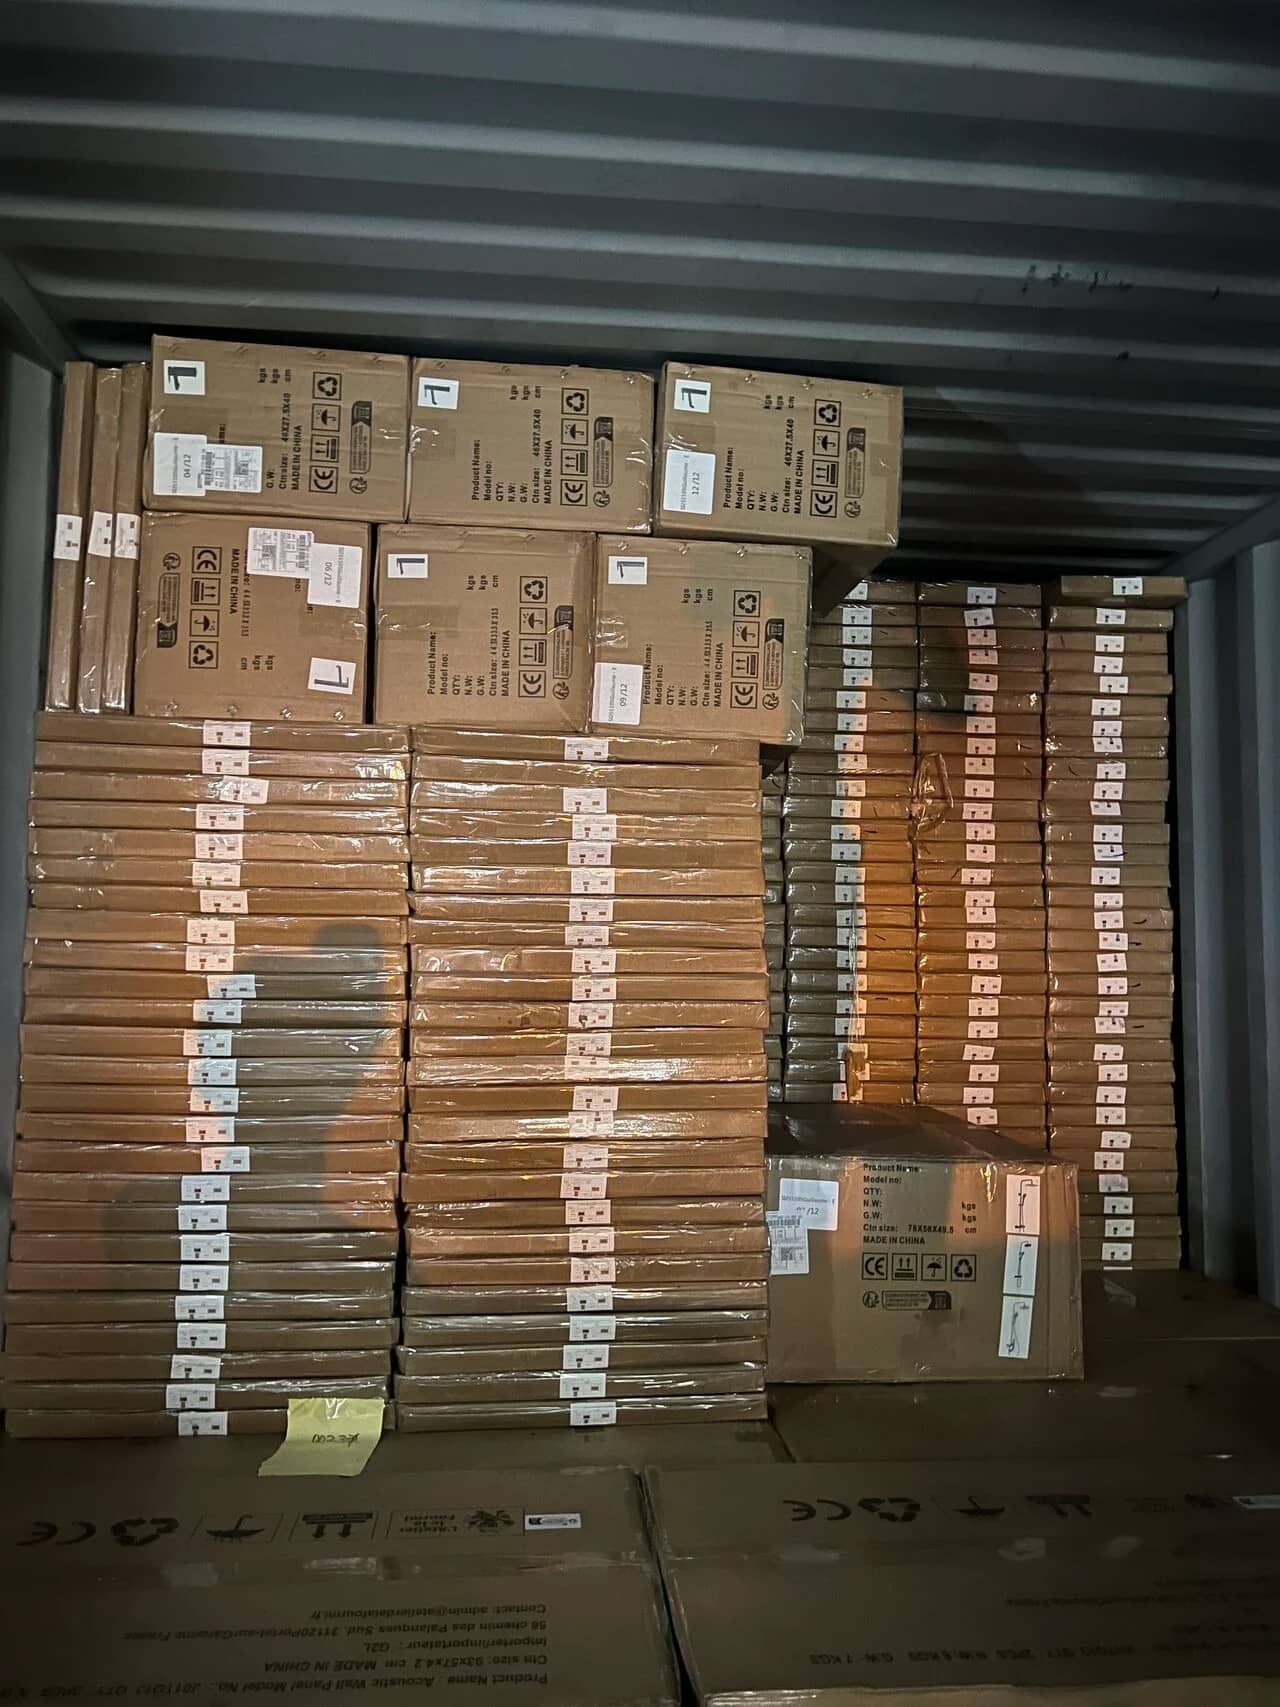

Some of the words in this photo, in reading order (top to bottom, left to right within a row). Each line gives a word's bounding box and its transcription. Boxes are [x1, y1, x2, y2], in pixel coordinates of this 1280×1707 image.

[283, 369, 291, 382] cm
[509, 385, 518, 400] kgs
[521, 385, 530, 400] kgs
[534, 385, 541, 398] cm
[787, 396, 795, 409] cm
[293, 425, 302, 452] CHINA
[293, 454, 301, 464] IN
[472, 439, 481, 466] Name:
[544, 440, 553, 467] CHINA
[725, 447, 734, 473] Name:
[796, 450, 804, 477] CHINA
[292, 465, 301, 490] MADE
[533, 468, 541, 487] size:
[544, 468, 552, 478] IN
[736, 468, 744, 482] no:
[472, 467, 481, 500] Product
[483, 476, 492, 501] Model
[783, 477, 792, 497] size:
[795, 479, 803, 488] IN
[496, 481, 505, 502] QTY:
[508, 482, 516, 502] N.W:
[520, 483, 528, 503] G.W:
[532, 489, 540, 503] Ctn
[544, 479, 552, 504] MADE
[724, 475, 732, 508] Product
[735, 484, 744, 509] Model
[747, 490, 755, 510] QTY:
[759, 491, 767, 511] N.W:
[771, 492, 779, 512] G.W:
[782, 499, 791, 513] Ctn
[794, 489, 803, 514] MADE
[231, 548, 240, 575] MADE
[324, 562, 333, 572] 06
[230, 576, 239, 585] IN
[466, 575, 475, 590] kgs
[478, 575, 487, 590] kgs
[491, 575, 499, 588] cm
[229, 587, 239, 614] CHINA
[681, 588, 691, 603] kgs
[693, 589, 702, 603] kgs
[706, 589, 713, 601] cm
[428, 632, 437, 659] Name:
[502, 630, 510, 658] CHINA
[241, 657, 248, 670] cm
[253, 655, 262, 670] kgs
[266, 655, 275, 670] kgs
[644, 644, 653, 670] Name:
[715, 643, 723, 669] CHINA
[502, 659, 510, 669] IN
[428, 660, 436, 694] Product
[440, 669, 448, 694] Model
[703, 671, 711, 690] size:
[715, 671, 722, 680] IN
[453, 675, 461, 695] QTY:
[465, 675, 473, 695] N.W:
[477, 676, 485, 696] G.W:
[489, 681, 497, 696] Ctn
[502, 671, 510, 696] MADE
[643, 672, 652, 704] Product
[655, 680, 663, 705] Model
[666, 685, 674, 705] QTY:
[678, 686, 686, 706] N.W:
[690, 687, 698, 706] G.W:
[702, 692, 710, 706] Ctn
[714, 682, 722, 707] MADE
[620, 696, 627, 706] 09
[863, 1163, 894, 1172] Product
[863, 1176, 886, 1184] Model
[863, 1188, 882, 1196] QTY:
[863, 1200, 882, 1208] N.W:
[962, 1201, 976, 1211] kgs
[863, 1212, 882, 1220] G.W:
[962, 1213, 976, 1222] kgs
[863, 1236, 887, 1244] MADE
[889, 1236, 898, 1244] IN
[899, 1236, 925, 1245] CHINA
[479, 1622, 528, 1631] chemin
[264, 1662, 310, 1672] CHINA
[314, 1662, 328, 1672] IN
[334, 1660, 377, 1671] MADE
[384, 1660, 406, 1668] cm
[524, 1655, 548, 1665] Ctn
[243, 1681, 287, 1692] Model
[291, 1680, 331, 1692] Panel
[335, 1680, 366, 1689] Wall
[371, 1677, 435, 1688] Acoustic
[447, 1675, 487, 1686] Name
[492, 1673, 548, 1685] Product
